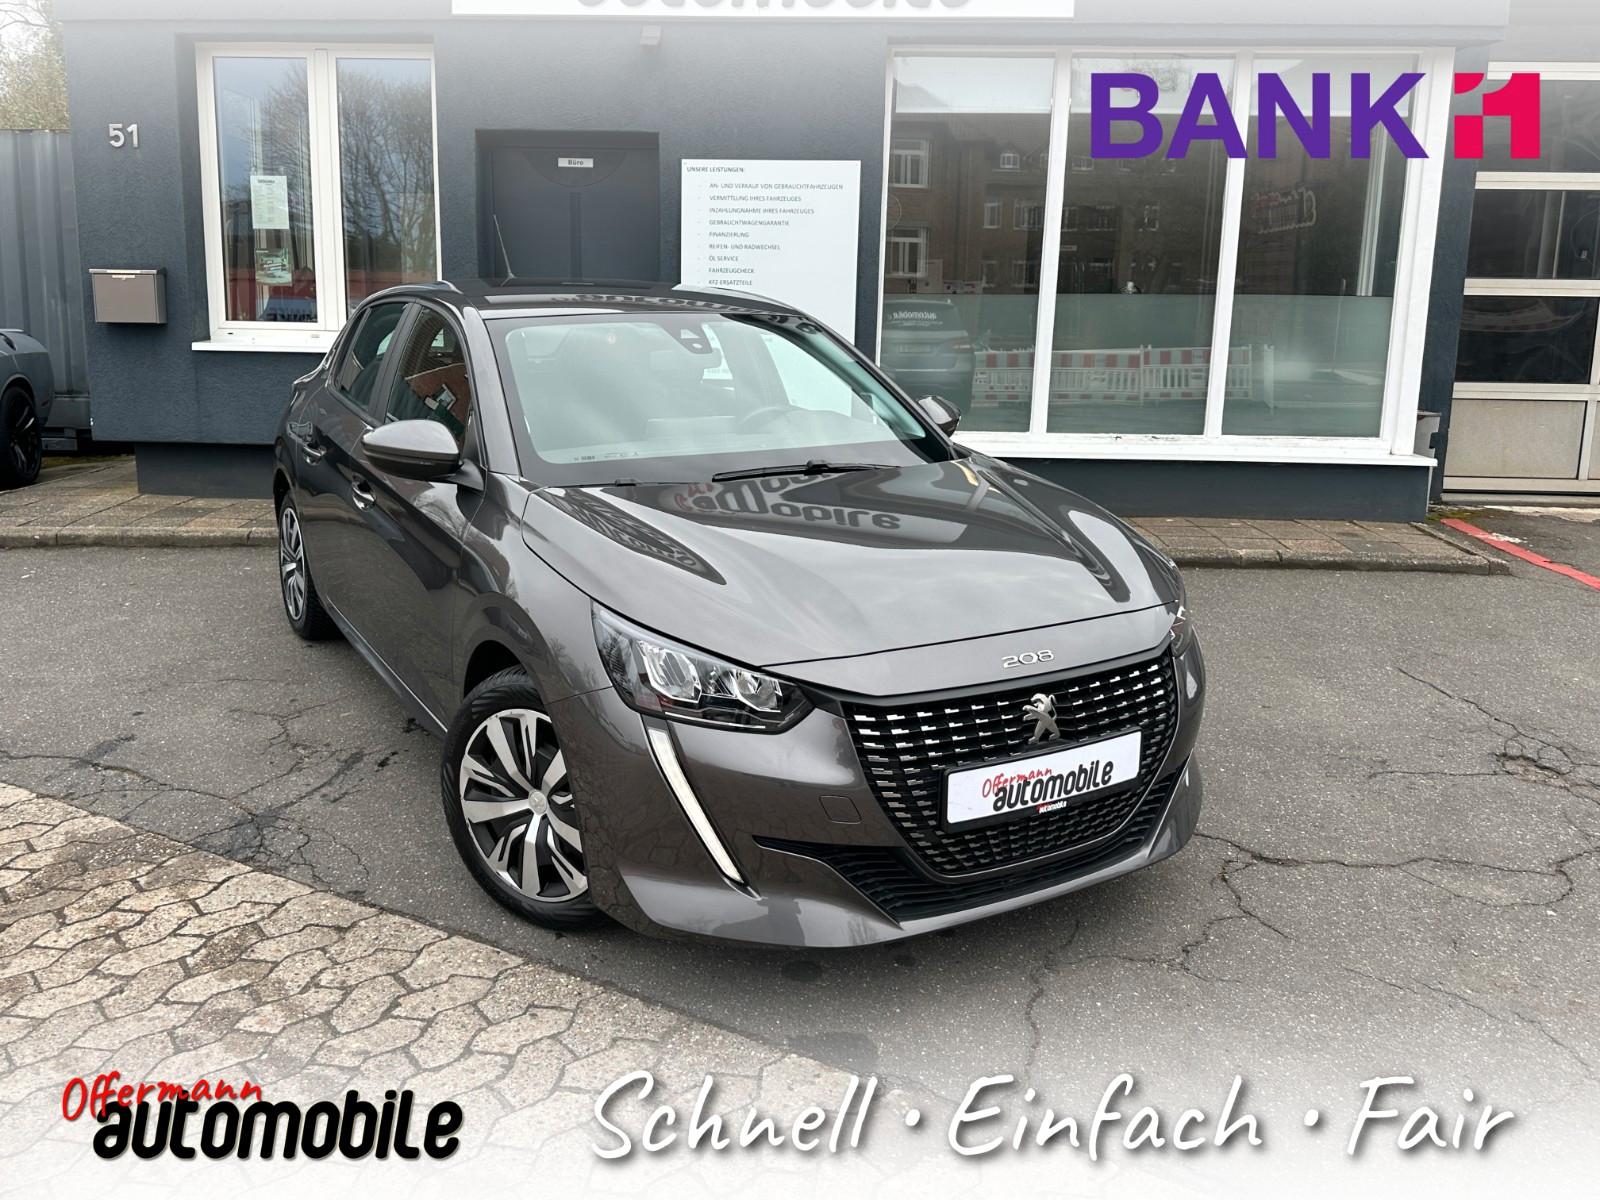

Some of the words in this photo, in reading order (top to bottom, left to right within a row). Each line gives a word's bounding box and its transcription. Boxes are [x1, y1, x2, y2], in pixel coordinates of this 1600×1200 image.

[109, 123, 138, 148] 51
[1001, 650, 1055, 668] 208
[982, 767, 1053, 798] Offermann
[993, 759, 1114, 812] automobile
